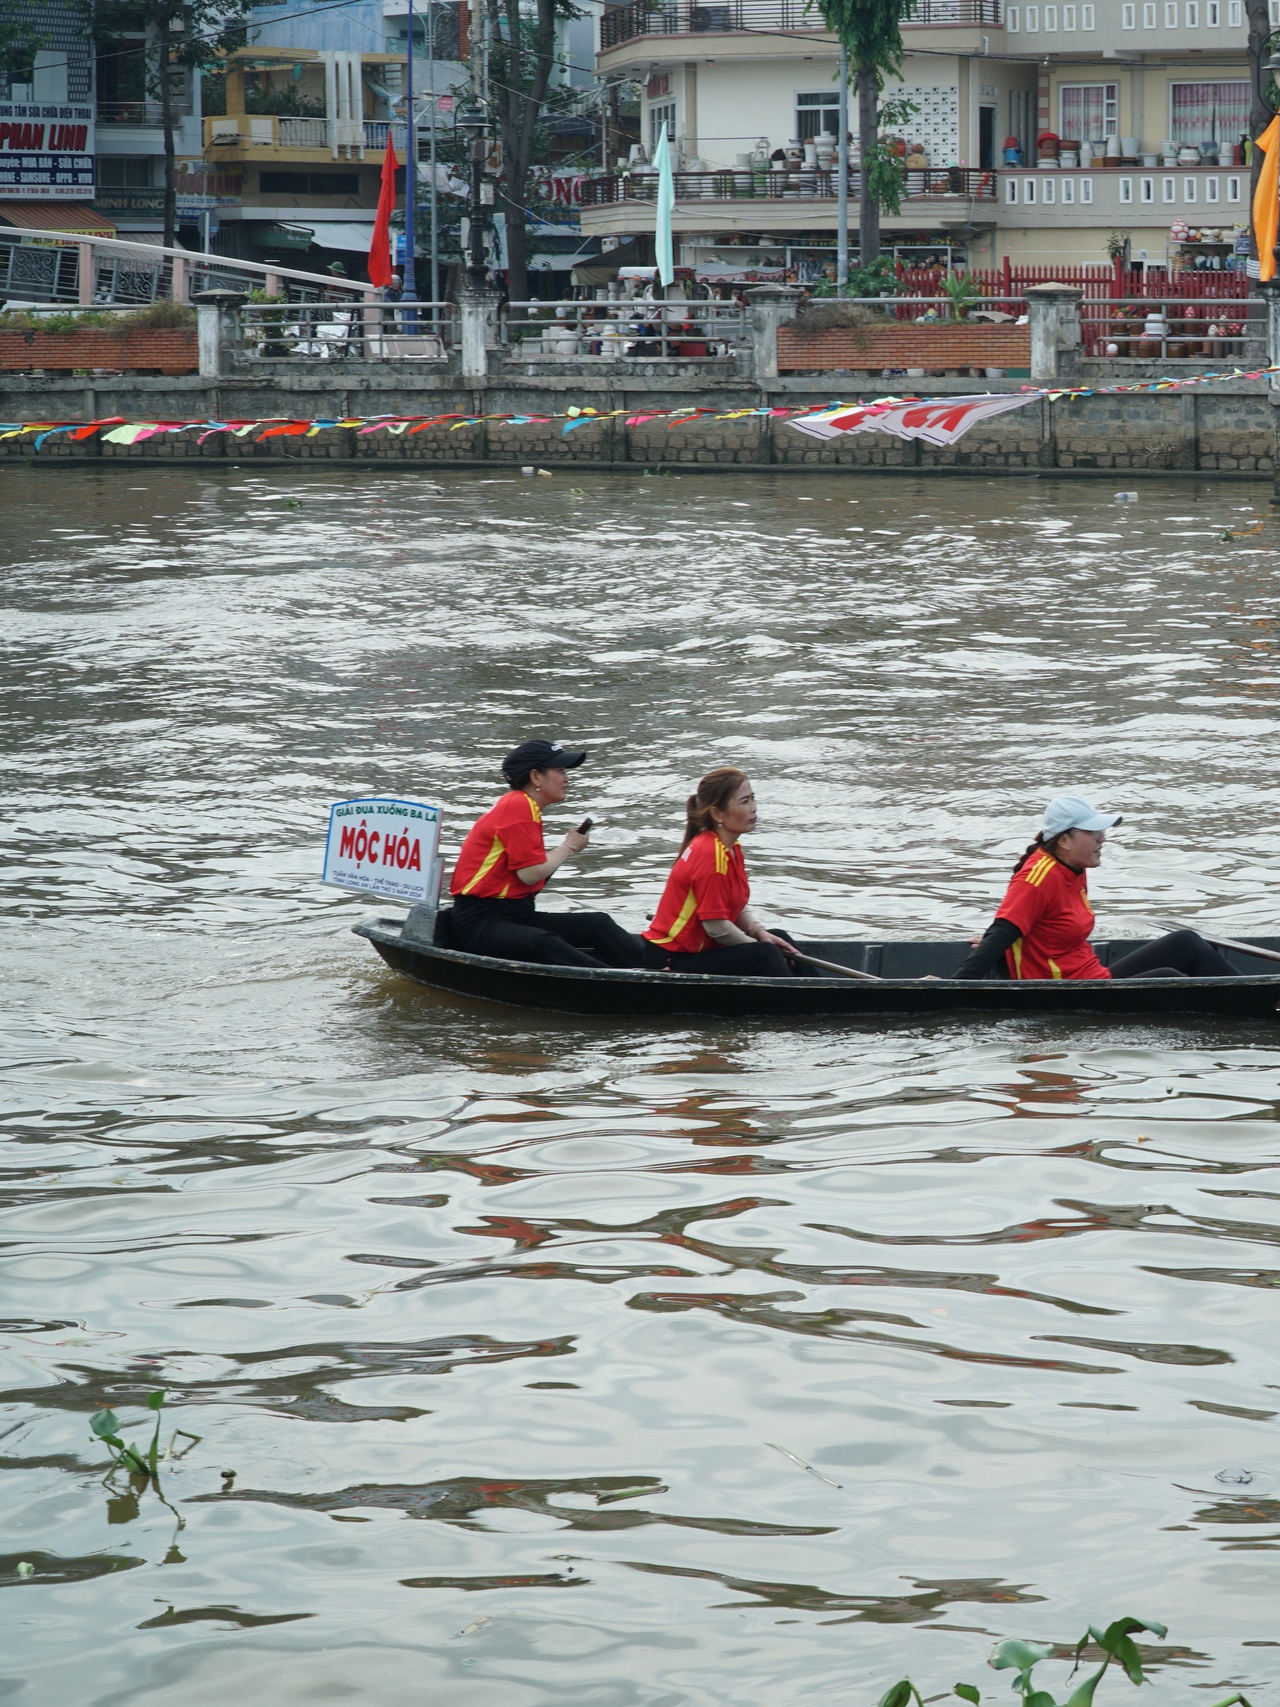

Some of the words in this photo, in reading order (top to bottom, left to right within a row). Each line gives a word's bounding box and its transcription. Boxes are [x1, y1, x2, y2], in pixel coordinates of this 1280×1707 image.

[0, 122, 45, 151] PHAN
[48, 123, 88, 151] LINH
[21, 157, 37, 168] MUA
[38, 156, 53, 168] BÁN
[73, 156, 93, 169] CHỮA
[20, 171, 51, 183] SAMSUNG
[55, 172, 73, 184] OPPO
[78, 172, 93, 184] VIVO
[93, 197, 128, 209] MINH
[131, 198, 165, 209] LONG
[336, 804, 354, 817] GIẢI
[355, 805, 375, 815] ĐUA
[411, 809, 423, 820] BA
[425, 811, 437, 823] LÁ
[339, 819, 380, 869] MỘC
[382, 826, 422, 872] HÓA
